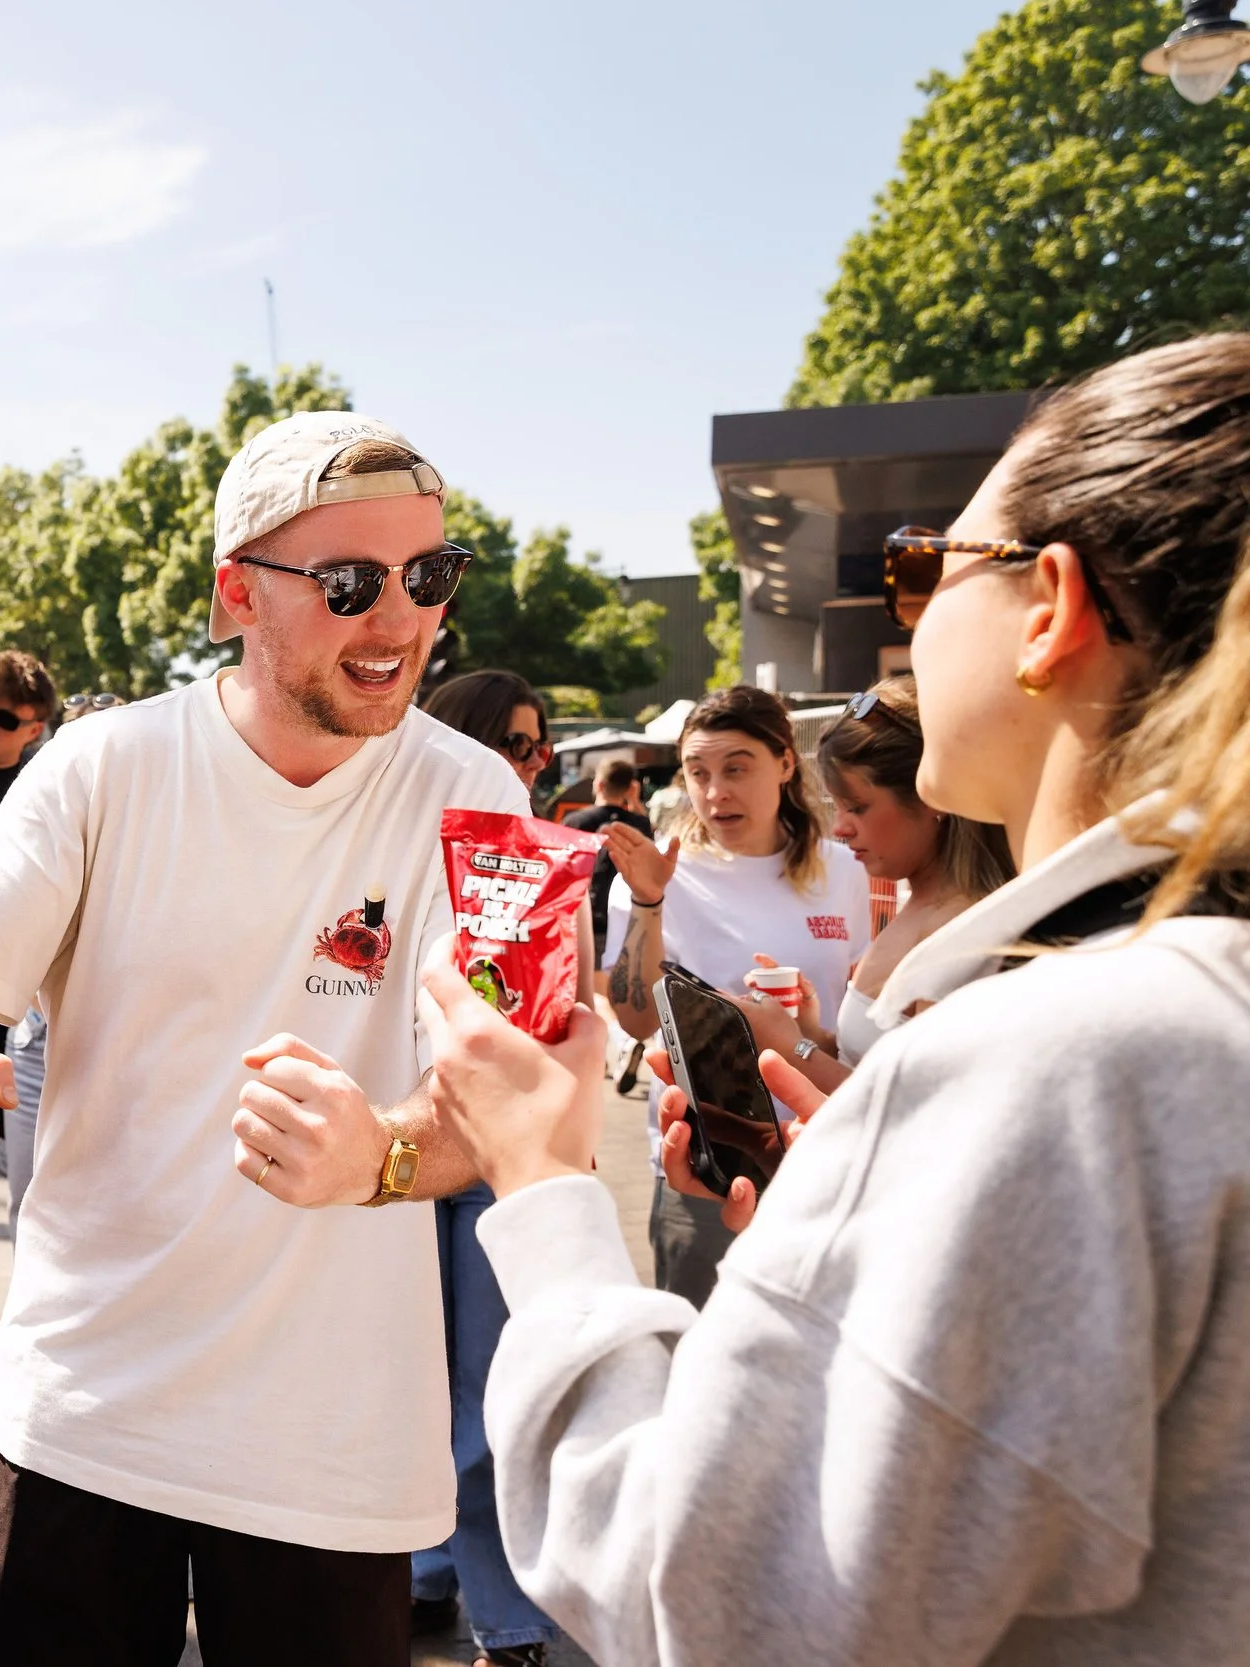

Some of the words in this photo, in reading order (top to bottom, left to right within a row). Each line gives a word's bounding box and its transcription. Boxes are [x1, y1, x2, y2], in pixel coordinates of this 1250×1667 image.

[474, 855, 498, 869] VAN
[461, 874, 542, 907] PICKLE
[305, 975, 381, 997] GUINNE
